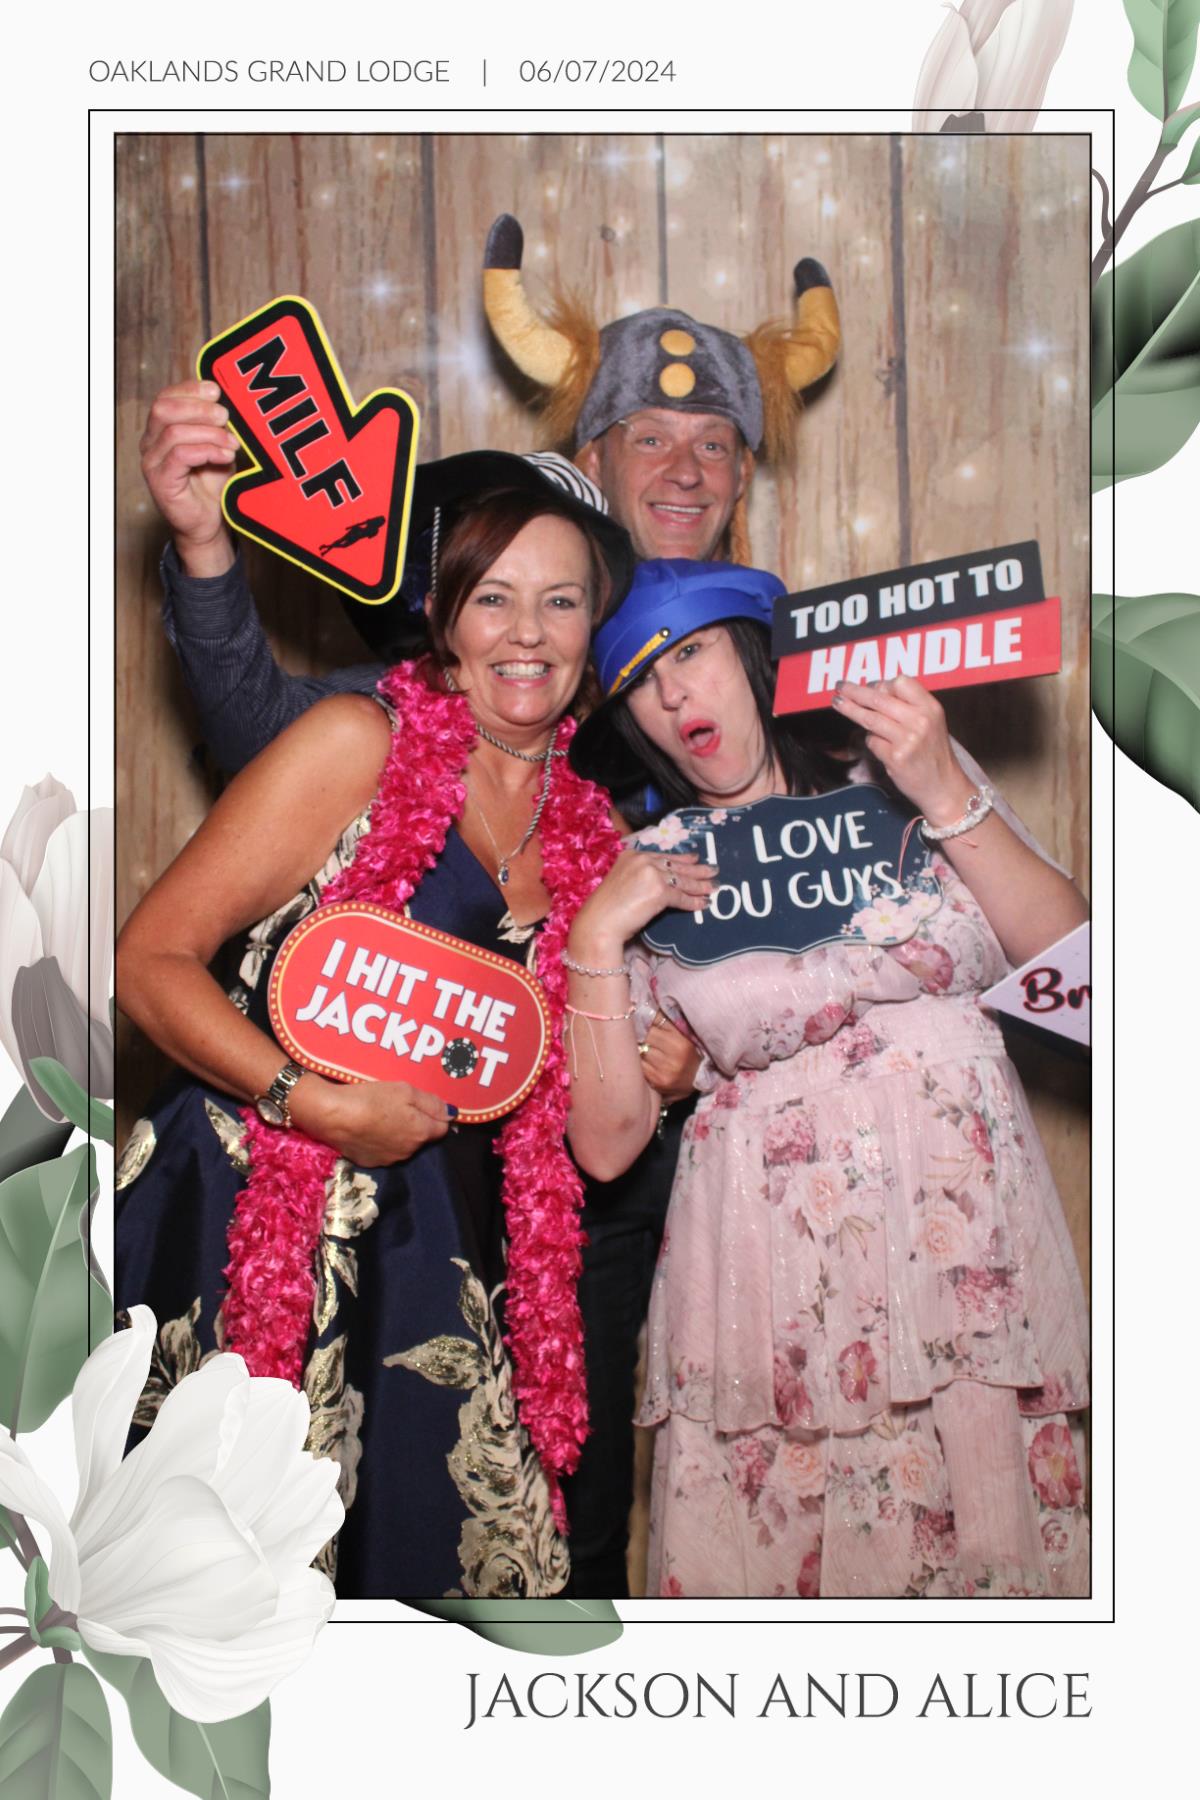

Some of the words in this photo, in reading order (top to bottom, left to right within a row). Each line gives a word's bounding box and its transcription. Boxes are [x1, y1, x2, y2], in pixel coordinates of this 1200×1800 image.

[235, 335, 364, 509] MILF
[790, 593, 869, 639] TOO
[879, 571, 960, 619] HOT
[968, 558, 1024, 597] TO
[807, 617, 1022, 694] HANDLE
[752, 811, 873, 863] LOVE
[693, 878, 773, 924] OU
[787, 861, 903, 909] GUYS
[320, 938, 347, 979] I
[345, 946, 429, 1007] HIT
[432, 977, 517, 1043] THE
